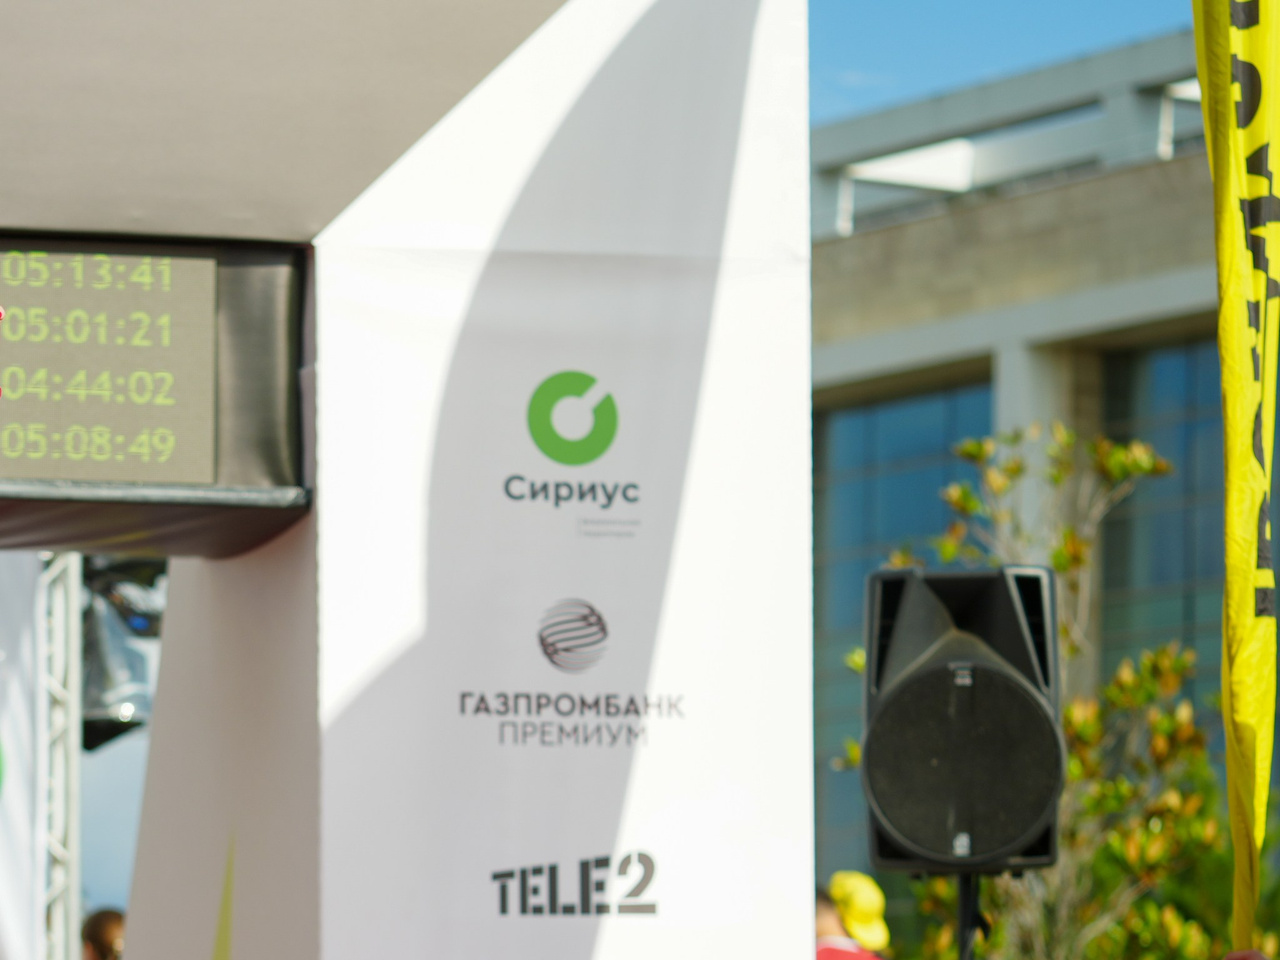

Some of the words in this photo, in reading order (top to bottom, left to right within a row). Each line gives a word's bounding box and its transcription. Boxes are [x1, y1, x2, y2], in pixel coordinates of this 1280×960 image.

[2, 250, 172, 292] 05:13:41
[2, 306, 171, 347] 05:01:21
[0, 366, 176, 406] 04:44:02
[0, 423, 176, 463] 05:08:49
[503, 475, 641, 509] Сириус
[459, 691, 685, 720] ГАЗПРОМБАНК
[499, 721, 648, 747] ПРЕМИУМ
[492, 851, 656, 915] TELE2
